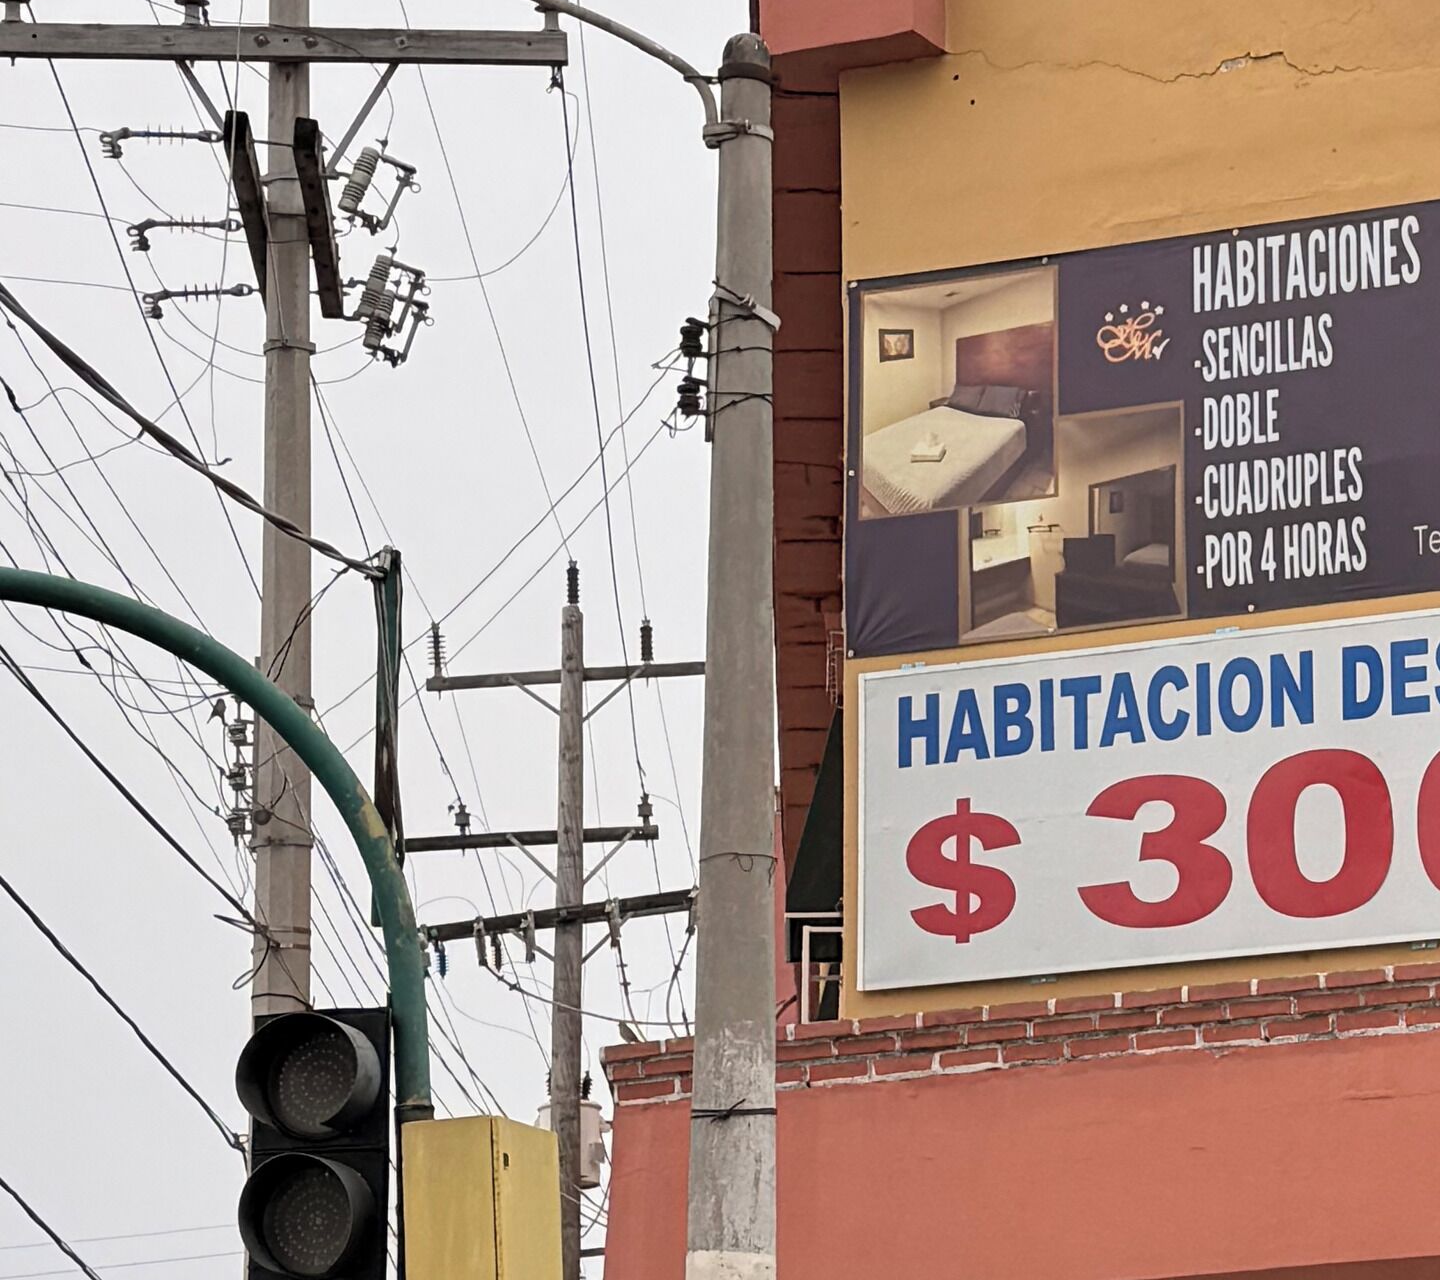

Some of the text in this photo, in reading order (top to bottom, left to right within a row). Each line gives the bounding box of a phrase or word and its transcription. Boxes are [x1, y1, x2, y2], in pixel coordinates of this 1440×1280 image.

[1193, 215, 1421, 314] HABITACIONES
[1202, 313, 1334, 382] SENCILLAS
[1203, 389, 1280, 450] DOBLE
[1203, 446, 1363, 519] CUADRUPLES
[1205, 516, 1367, 589] POR 4 HORAS
[898, 650, 1314, 769] HABITACION
[905, 797, 1022, 945] $
